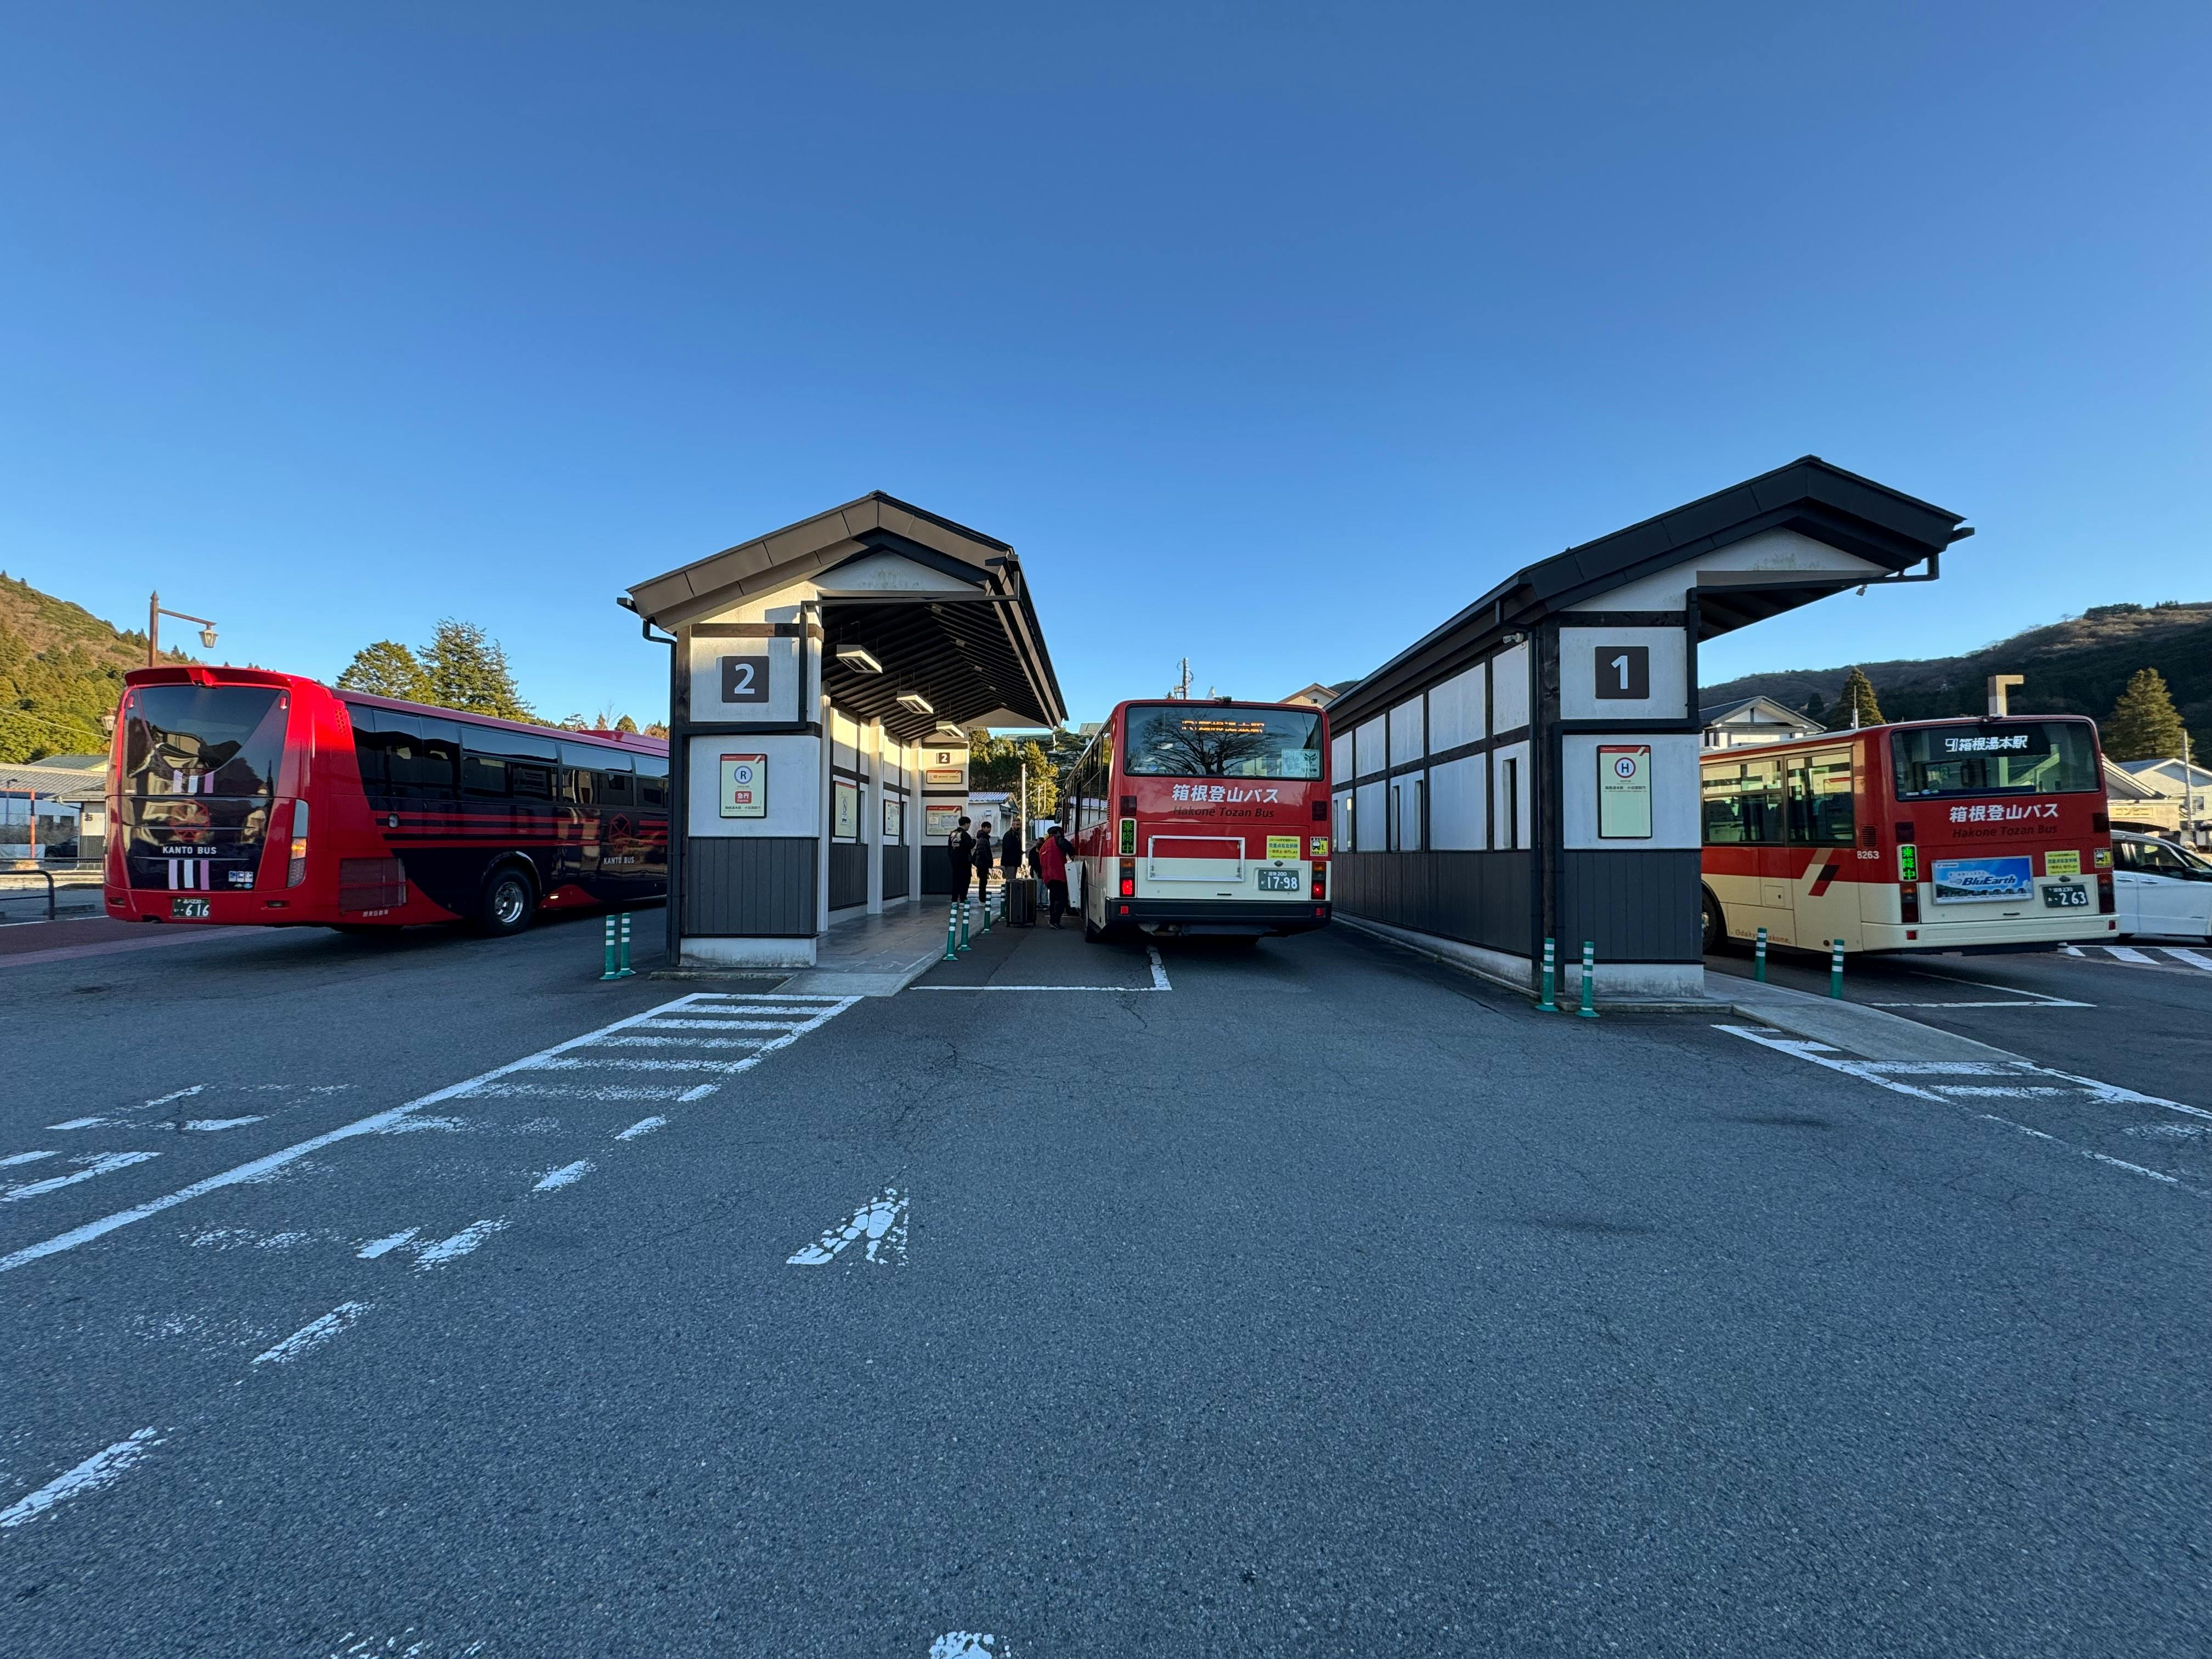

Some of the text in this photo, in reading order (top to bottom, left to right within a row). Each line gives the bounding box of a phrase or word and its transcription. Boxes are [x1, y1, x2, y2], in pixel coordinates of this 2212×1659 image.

[734, 663, 755, 695] 2
[1611, 655, 1629, 690] 1
[1959, 735, 2028, 752] 箱根湯本駅
[941, 754, 948, 763] 2
[740, 770, 747, 780] R
[1621, 763, 1629, 773] H
[1171, 783, 1279, 804] 箱根登山バス
[1173, 805, 1274, 818] Hakone Tozan Bus
[1949, 803, 2059, 823] 箱根登山バス
[1122, 820, 1133, 854] 乗降中
[1953, 824, 2058, 839] Hakone Tozan Bus
[162, 846, 193, 854] KANTO
[603, 856, 622, 865] KANTO
[1901, 845, 1916, 881] 乗降中
[1962, 875, 2017, 886] BluEarth
[185, 904, 210, 916] 616
[1735, 929, 1790, 943] Odaky akone
